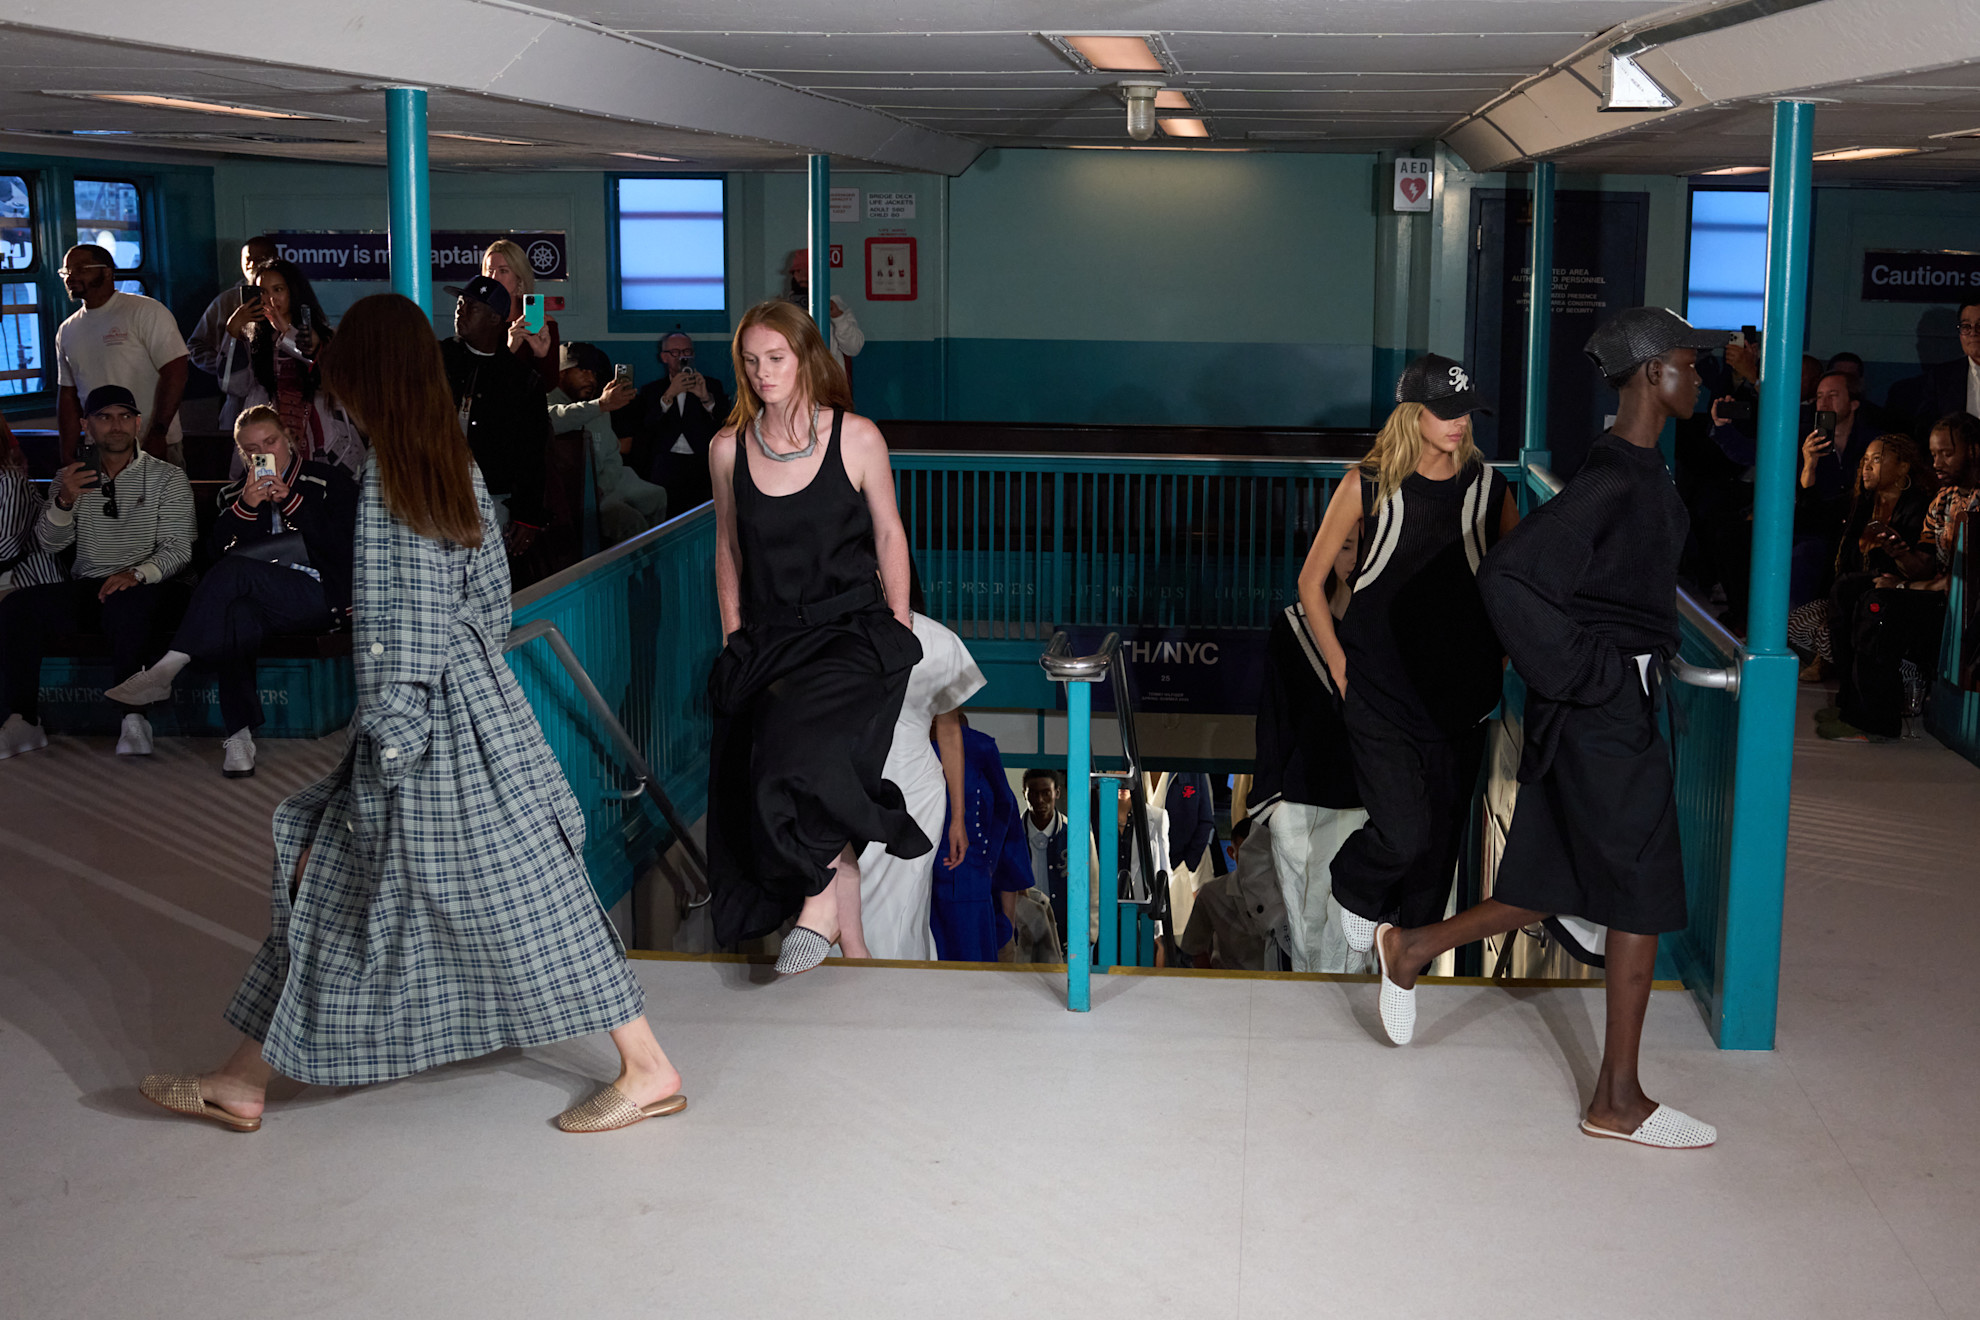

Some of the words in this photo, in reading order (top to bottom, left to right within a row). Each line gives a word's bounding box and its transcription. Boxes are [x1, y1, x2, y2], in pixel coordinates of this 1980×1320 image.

[1400, 162, 1428, 173] AED
[275, 244, 350, 268] Tommy
[353, 244, 371, 264] is
[374, 250, 389, 264] m
[430, 245, 482, 268] aptai
[830, 250, 841, 264] 0
[1561, 276, 1606, 284] PERSONNEL
[1871, 264, 1966, 286] Caution:
[38, 687, 106, 703] SERVERS
[192, 688, 288, 704] PREERS
